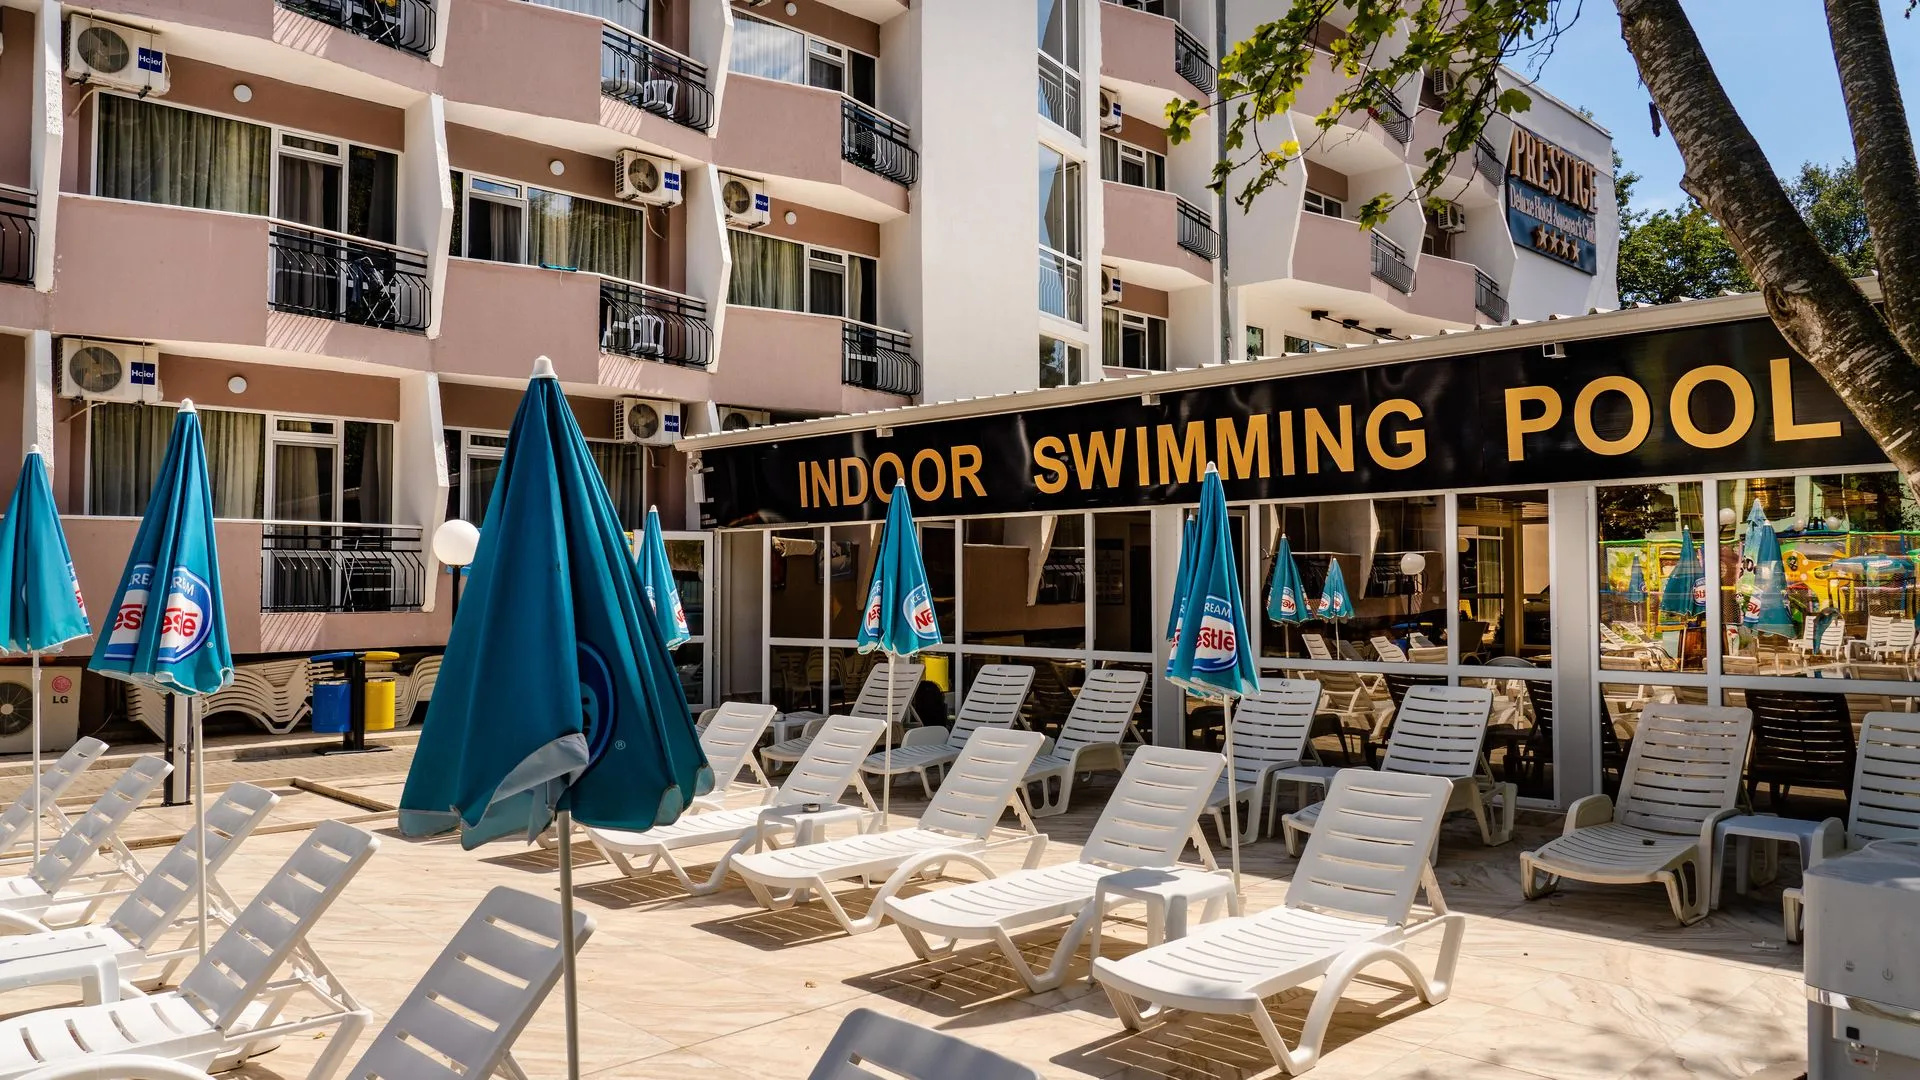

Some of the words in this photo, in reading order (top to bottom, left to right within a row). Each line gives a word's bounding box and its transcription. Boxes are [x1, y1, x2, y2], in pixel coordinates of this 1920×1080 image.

[139, 54, 162, 66] Haier
[1510, 130, 1598, 214] PRESTIGE
[131, 369, 154, 378] Haier
[799, 444, 988, 508] INDOOR
[1033, 398, 1426, 493] SWIMMING
[1504, 357, 1843, 462] POOL
[1204, 603, 1231, 618] REAM
[1196, 627, 1234, 651] estlé
[53, 696, 69, 704] LG
